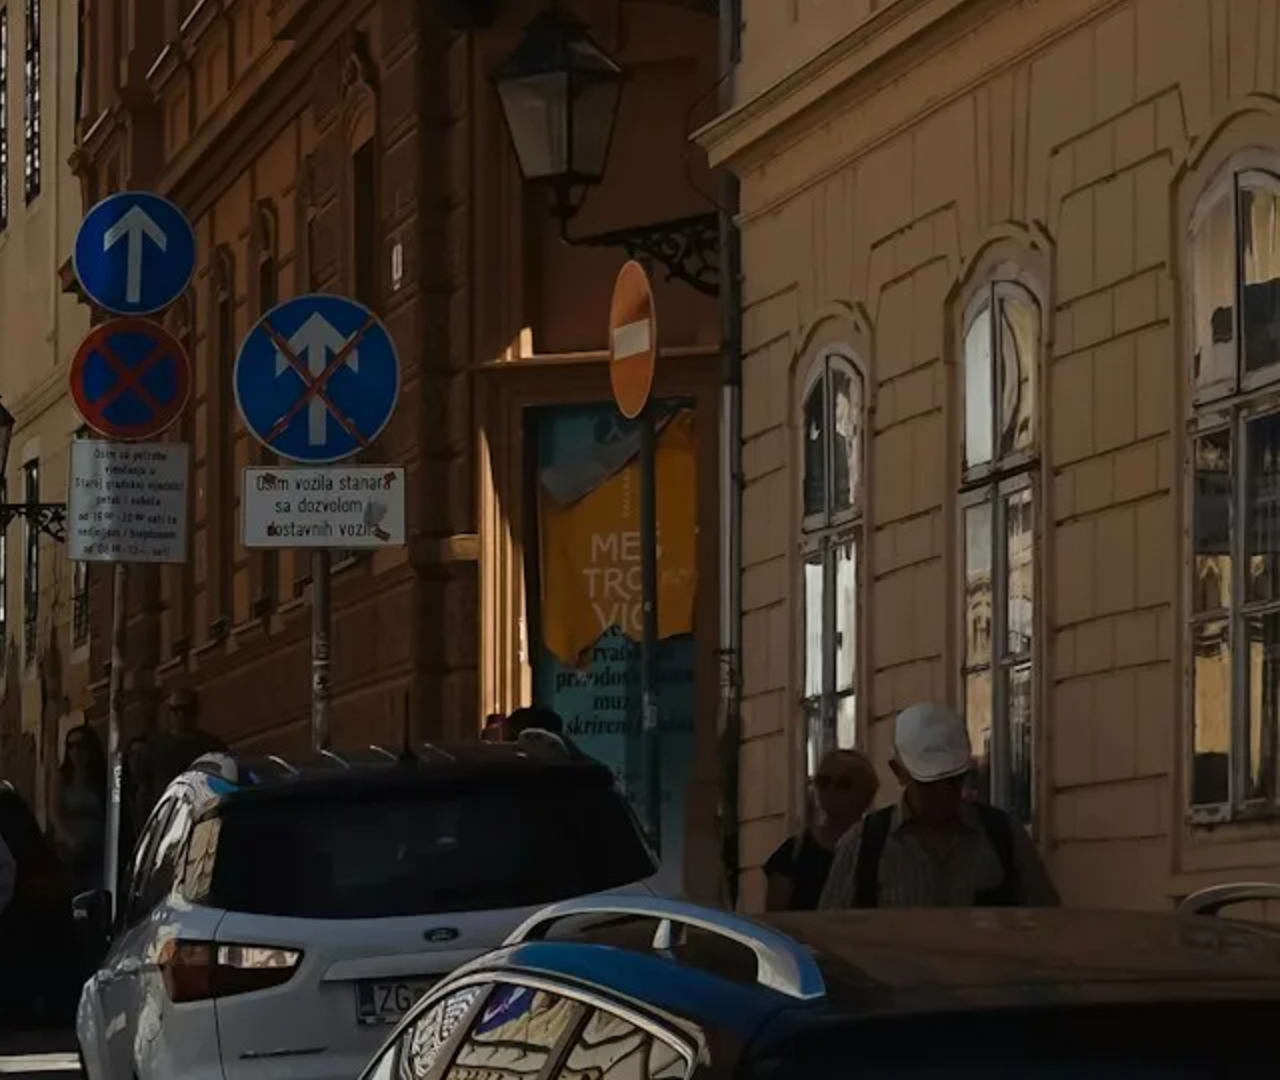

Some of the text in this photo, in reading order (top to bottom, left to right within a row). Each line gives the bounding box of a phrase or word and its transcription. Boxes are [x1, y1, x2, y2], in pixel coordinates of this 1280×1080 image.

[295, 475, 333, 491] vozila
[275, 500, 290, 513] sa
[297, 497, 363, 513] dozvolom
